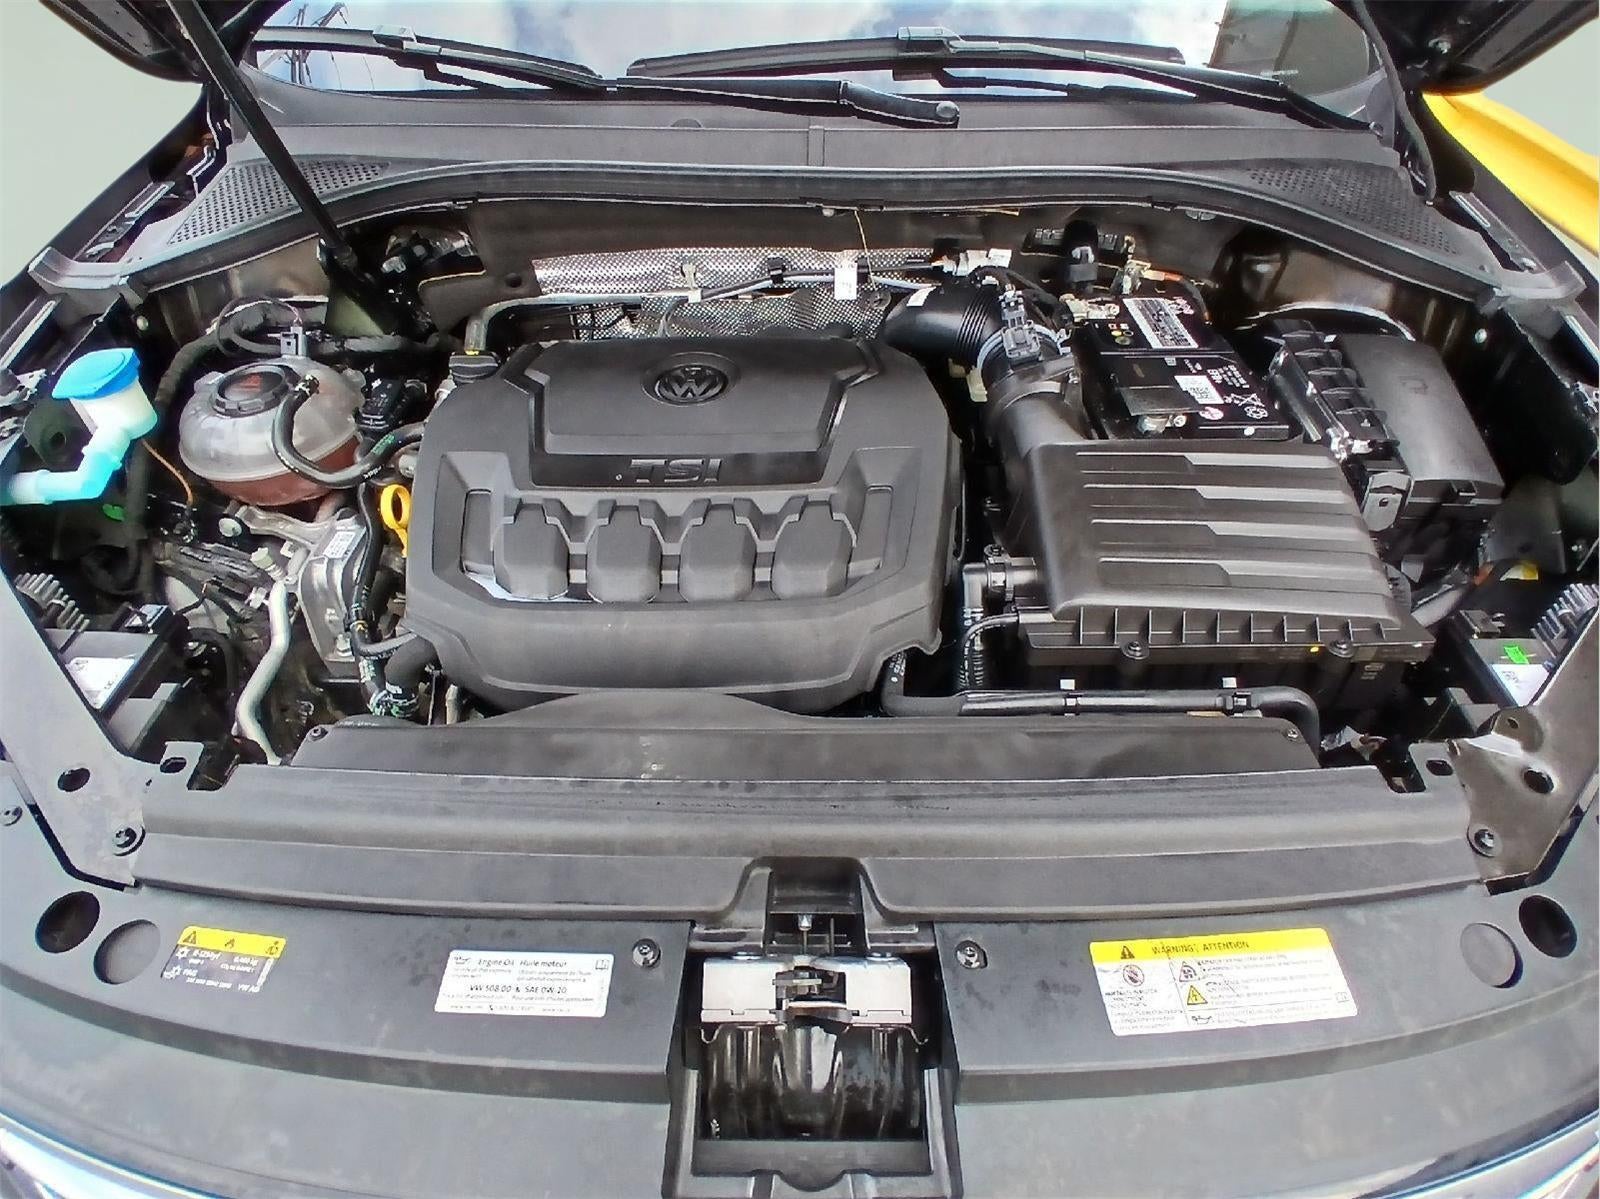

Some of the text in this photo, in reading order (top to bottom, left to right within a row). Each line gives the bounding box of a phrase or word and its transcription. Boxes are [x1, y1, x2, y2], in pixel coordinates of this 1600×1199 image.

[630, 458, 722, 483] TSI
[1202, 941, 1250, 951] ATTENTION
[478, 959, 502, 968] Engine
[519, 959, 539, 967] Huile
[524, 985, 539, 993] SAE
